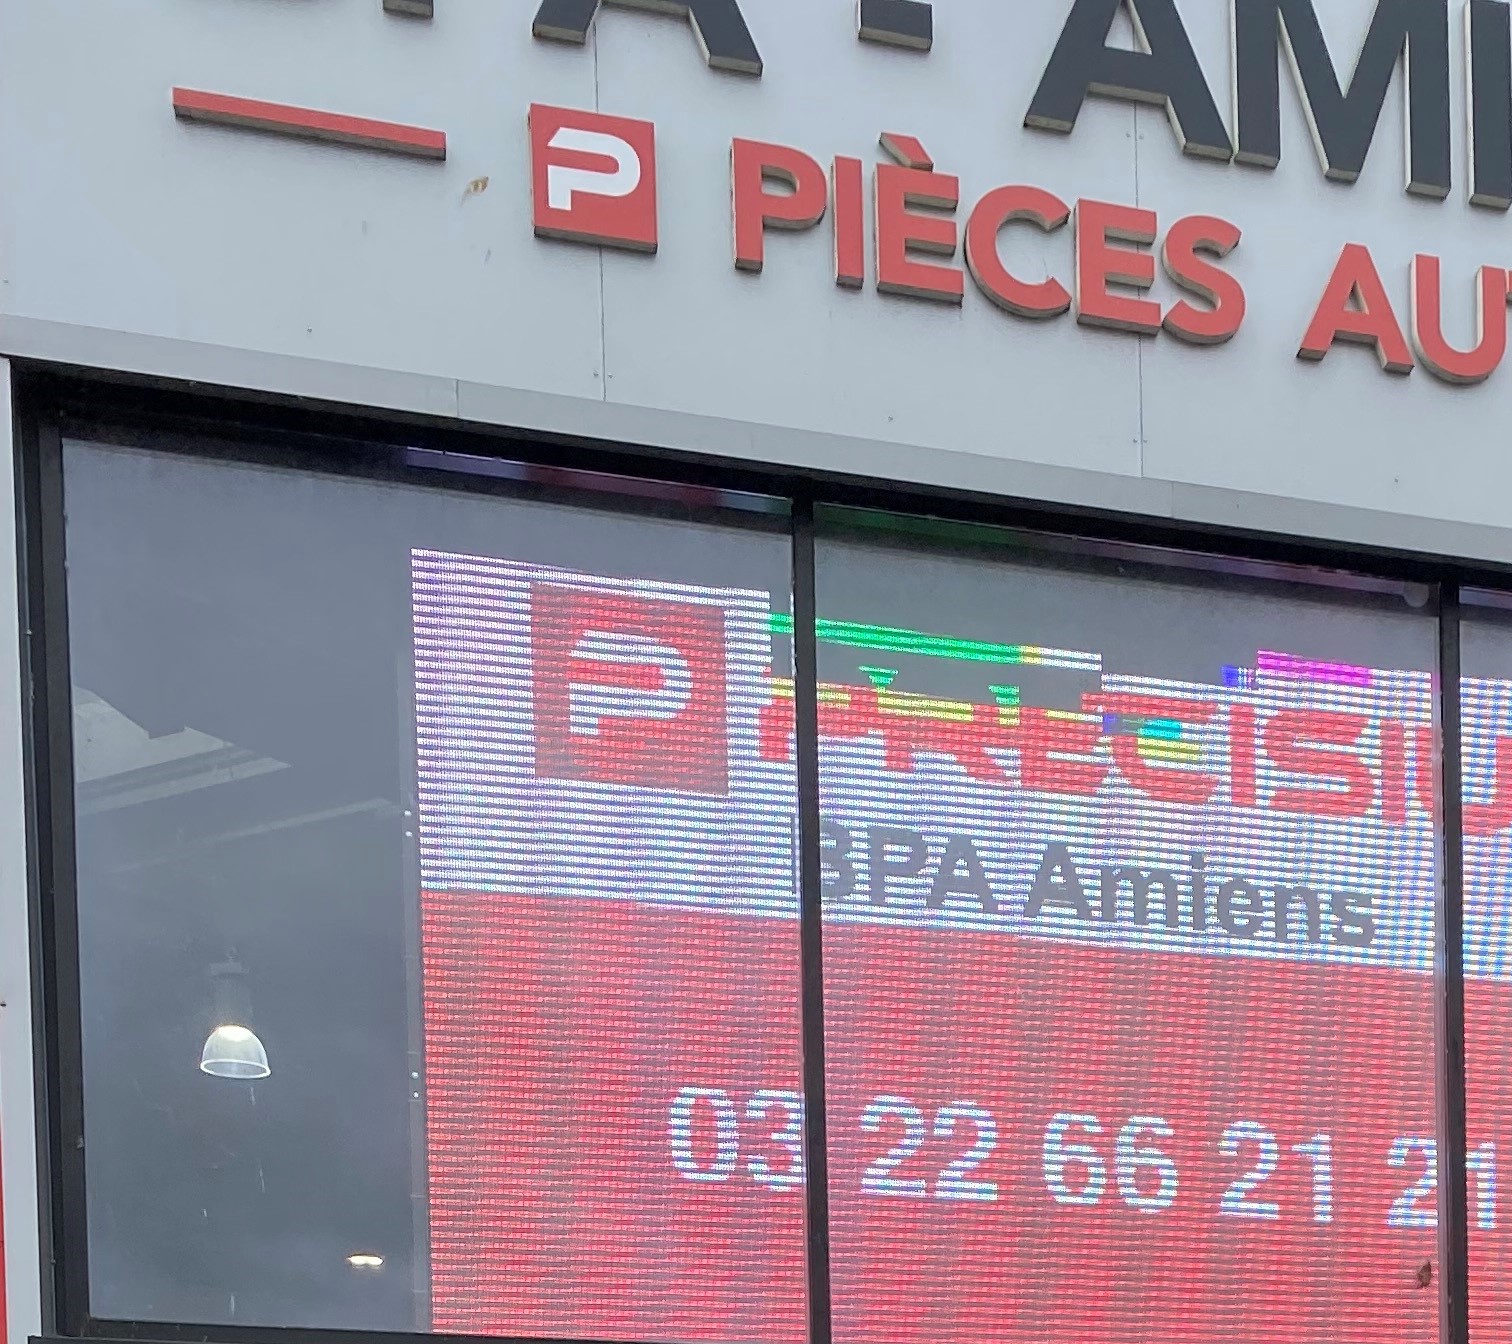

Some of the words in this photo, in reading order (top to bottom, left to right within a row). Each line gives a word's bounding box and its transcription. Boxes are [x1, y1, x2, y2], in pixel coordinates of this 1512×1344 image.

[730, 131, 1245, 344] PIÈCES
[1023, 844, 1376, 949] Amiens
[667, 1086, 806, 1191] 03
[858, 1094, 999, 1200] 22
[1042, 1112, 1179, 1213] 66
[1218, 1119, 1334, 1224] 21
[1387, 1135, 1498, 1228] 21
